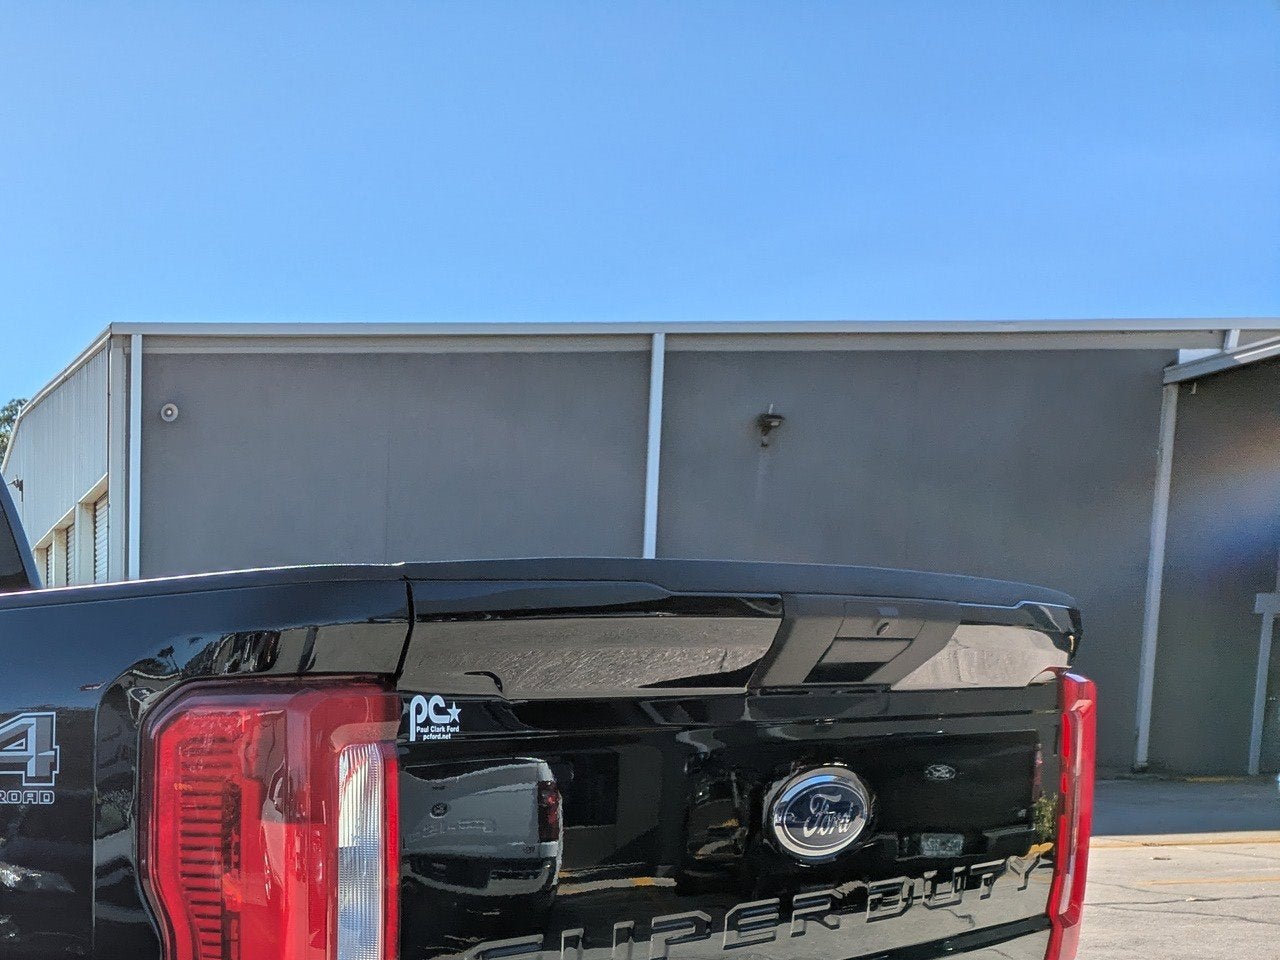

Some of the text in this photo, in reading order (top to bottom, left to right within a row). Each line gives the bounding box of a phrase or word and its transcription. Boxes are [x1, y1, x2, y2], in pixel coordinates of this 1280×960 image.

[423, 733, 451, 741] pcford.net
[802, 792, 855, 838] Ford
[864, 846, 1050, 924] DUTY
